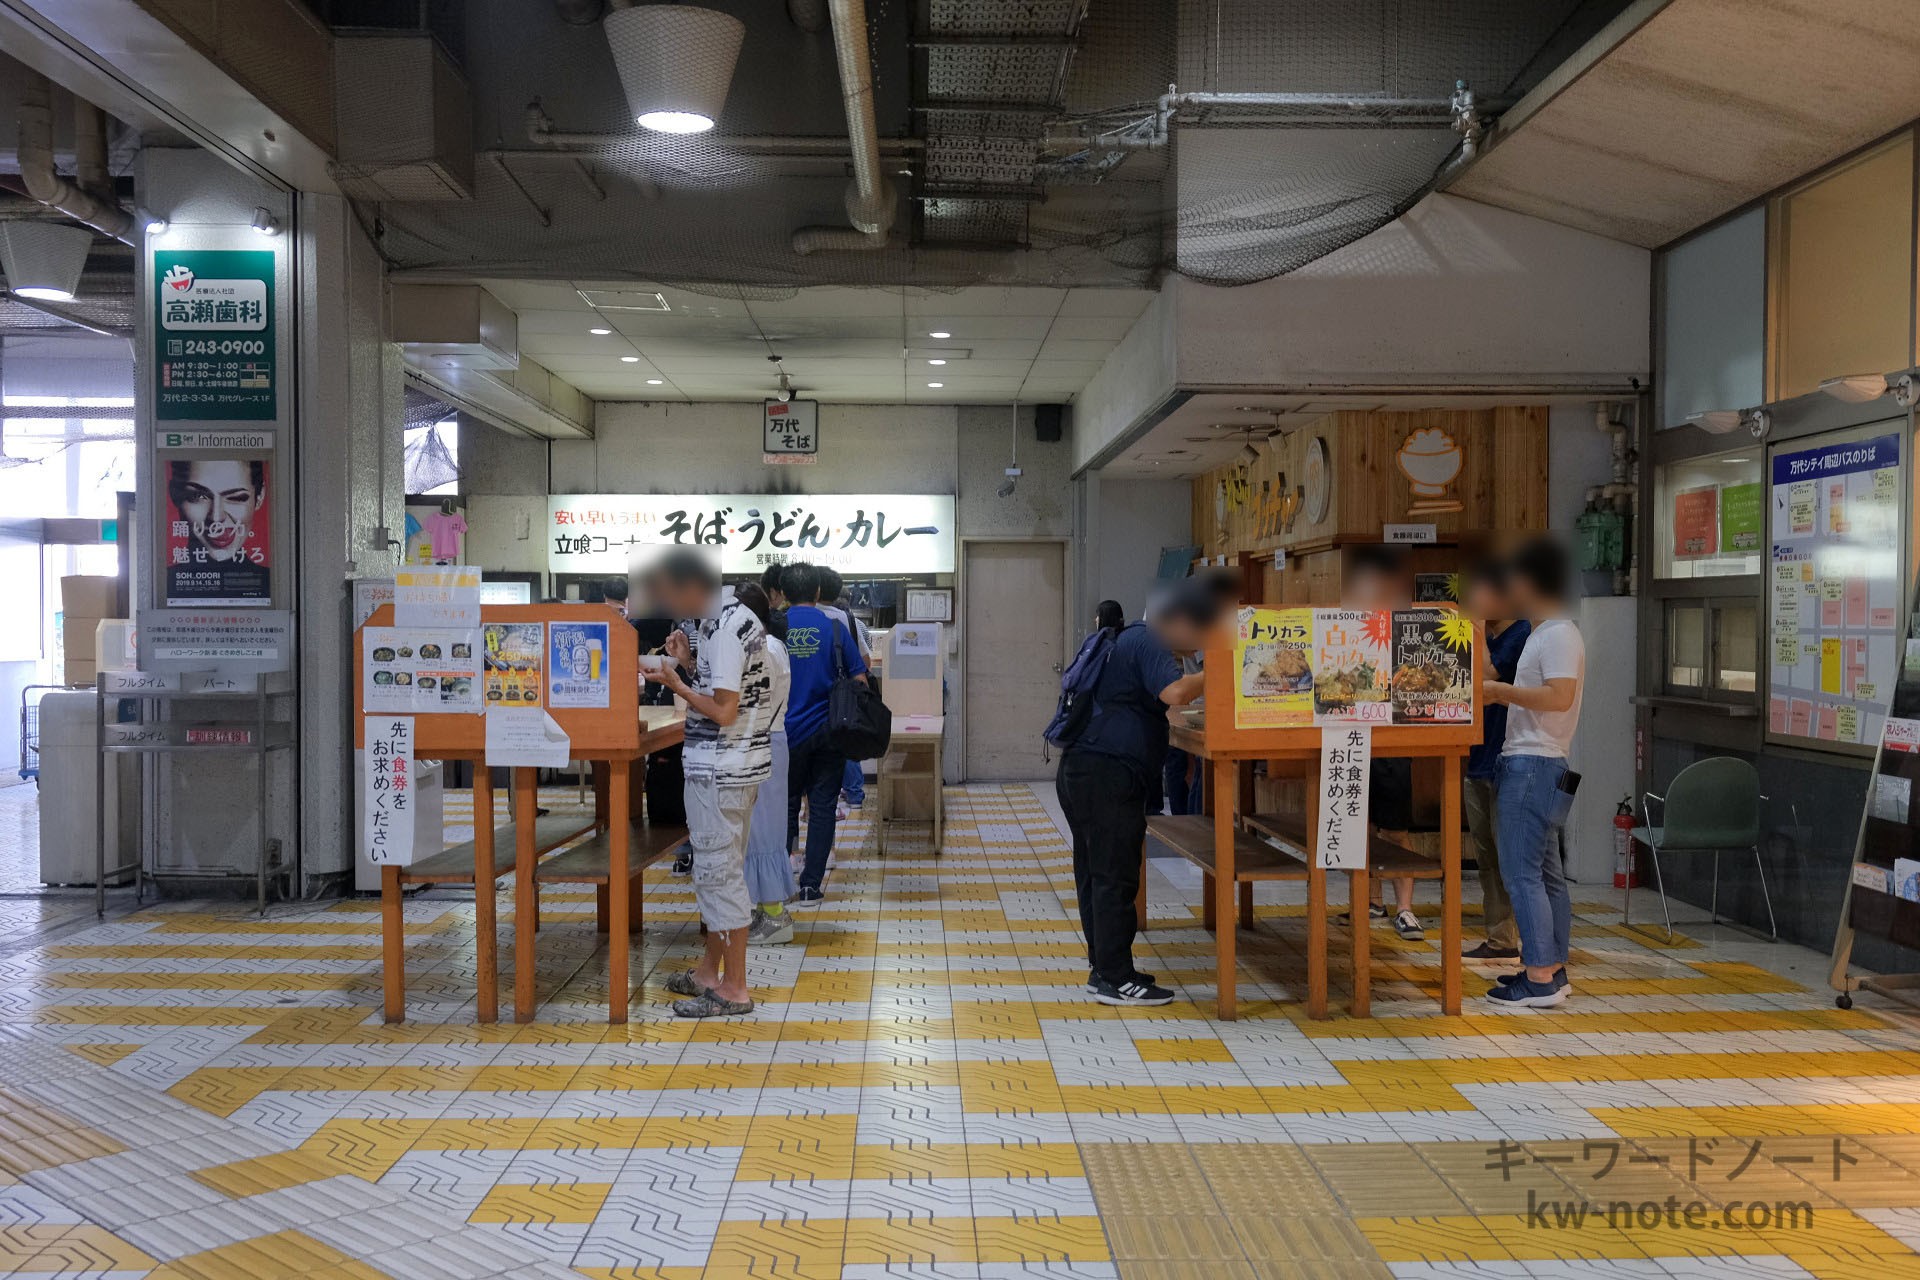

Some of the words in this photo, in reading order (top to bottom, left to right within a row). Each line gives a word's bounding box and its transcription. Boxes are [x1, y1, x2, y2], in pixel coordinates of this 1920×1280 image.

[166, 299, 263, 323] 高瀬歯科
[185, 340, 265, 355] 243-0900
[770, 418, 800, 433] 万代
[198, 434, 264, 447] Information
[781, 434, 811, 449] そば
[172, 547, 265, 563] 魅せけろ
[1251, 621, 1307, 640] トリカラ
[1401, 624, 1433, 645] 黒の
[1398, 646, 1459, 668] トリカラ
[118, 678, 165, 688] フルタイム
[118, 731, 166, 741] フルタイム
[390, 721, 408, 810] 先に食券を
[1345, 730, 1364, 817] 先に食券を
[371, 739, 390, 862] お求めください
[1324, 748, 1345, 866] お求めください
